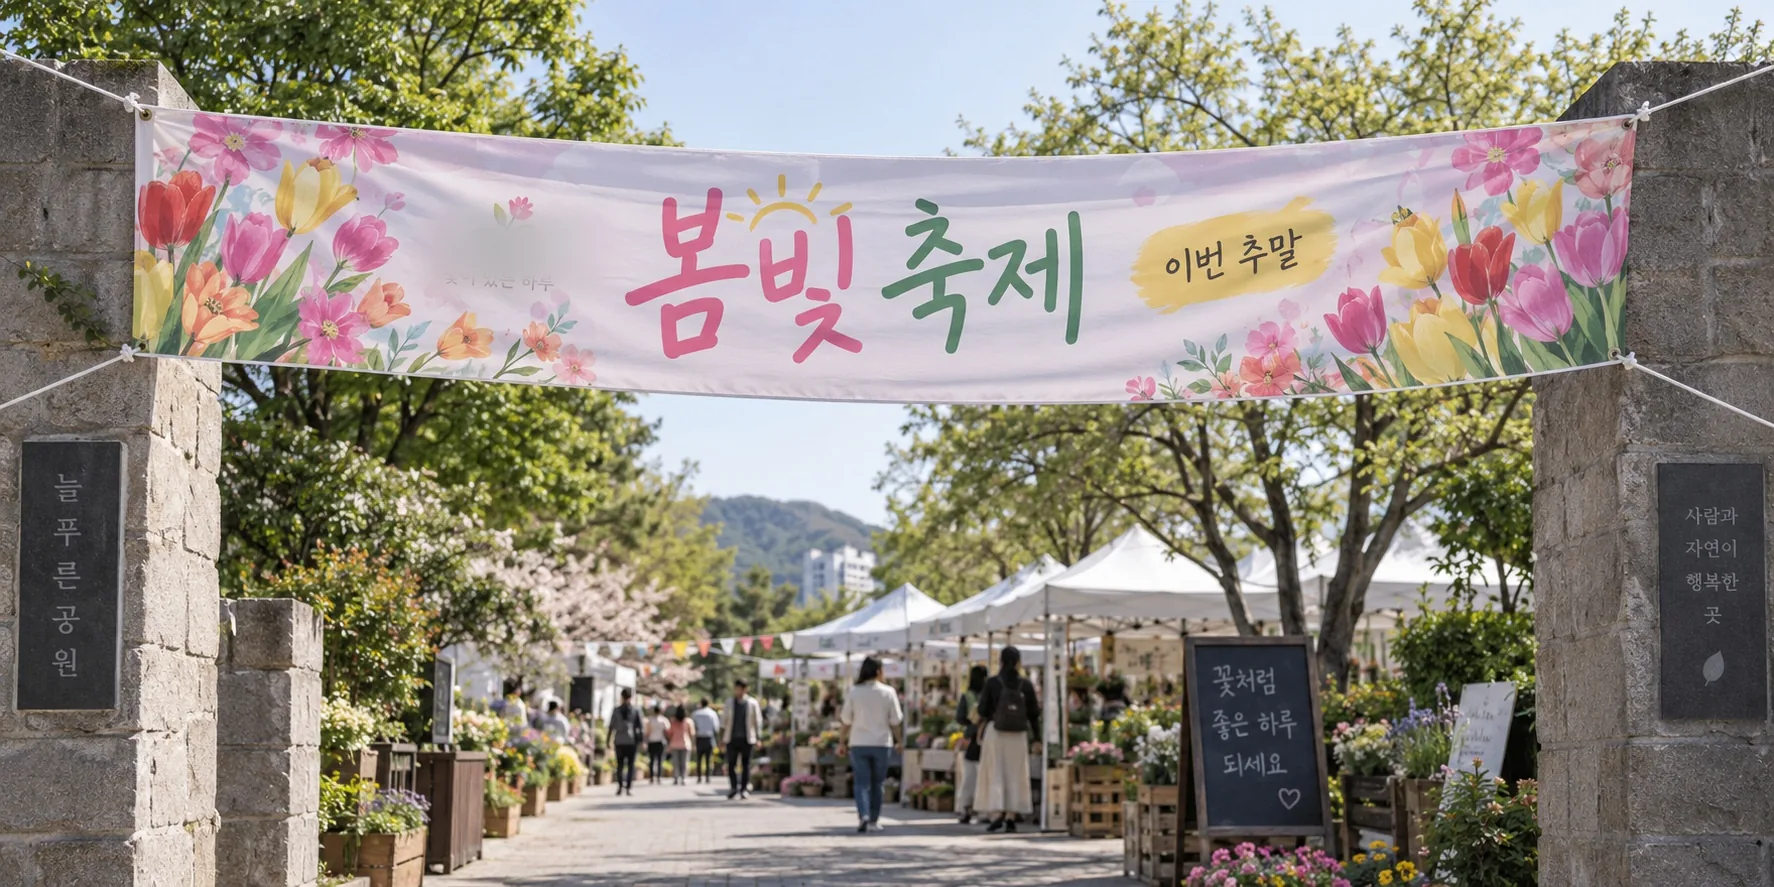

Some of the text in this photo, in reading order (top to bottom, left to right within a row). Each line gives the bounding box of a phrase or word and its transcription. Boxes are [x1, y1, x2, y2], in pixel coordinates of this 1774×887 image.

[1165, 228, 1303, 283] 이번 추말
[624, 187, 1084, 364] 봄빛 축제
[1685, 506, 1739, 526] 사람과
[1685, 538, 1738, 558] 자연이
[52, 473, 82, 677] 늘푸른공원
[1685, 572, 1740, 592] 행복한
[1703, 606, 1722, 625] 곳
[1212, 664, 1276, 698] 꽃처럼
[1212, 709, 1298, 741] 좋은 하루
[1223, 752, 1288, 778] 되세요
